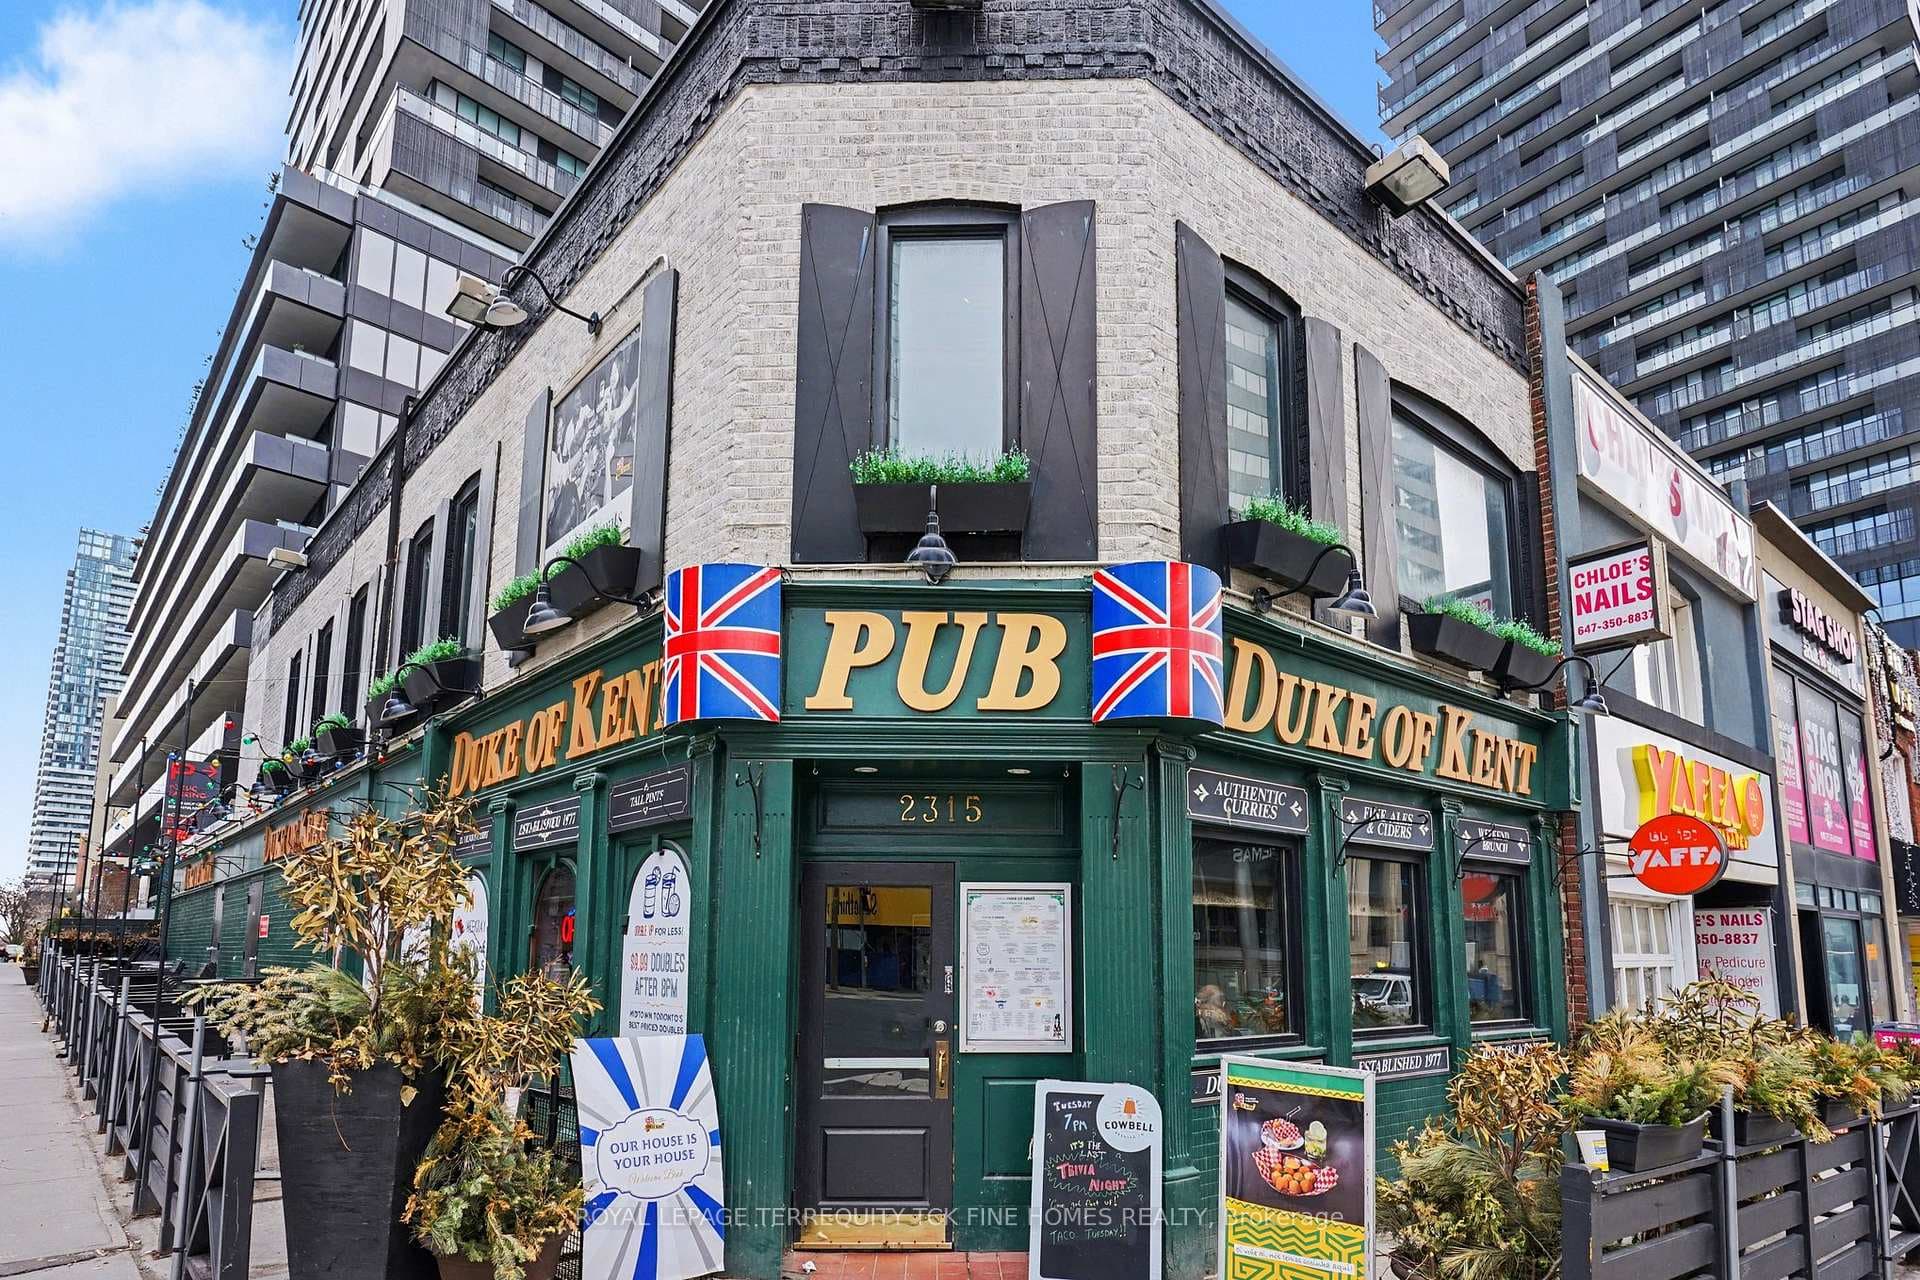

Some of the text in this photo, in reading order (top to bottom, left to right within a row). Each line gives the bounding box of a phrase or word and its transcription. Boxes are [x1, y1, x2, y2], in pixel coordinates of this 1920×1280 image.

[1574, 555, 1651, 589] CHLOE'S
[1575, 576, 1654, 616] NAILS
[1577, 608, 1654, 635] 647-350-8837
[1790, 587, 1826, 642] STAG
[1824, 615, 1857, 664] SHOP
[805, 611, 1067, 712] PUB
[1224, 637, 1538, 795] DUKE OF KENT
[448, 720, 524, 800] DUKE
[525, 700, 568, 774] OF
[1805, 719, 1838, 767] STAG
[1643, 744, 1743, 831] YAFFA
[1808, 759, 1841, 802] SHOP
[1214, 780, 1287, 806] AUTHENTIC
[900, 794, 983, 823] 2315
[1223, 799, 1278, 820] CURRIES
[518, 815, 562, 836] ESTABLISHED
[1366, 822, 1413, 839] & CIDERS
[1629, 846, 1721, 875] YAFFA
[1720, 914, 1763, 927] NAILS
[655, 928, 667, 937] FOR
[650, 952, 686, 973] DOUBLES
[1715, 956, 1766, 969] Pedicure
[634, 976, 658, 997] AFTER
[1359, 1053, 1442, 1073] ESTABLISHED 1977
[1104, 1121, 1155, 1133] COWBELL
[610, 1133, 697, 1155] OUR HOUSE IS
[1087, 1140, 1102, 1151] THE
[614, 1149, 696, 1170] YOUR HOUSE
[1056, 1163, 1095, 1180] TRIVIA
[1088, 1178, 1127, 1192] NIGHT
